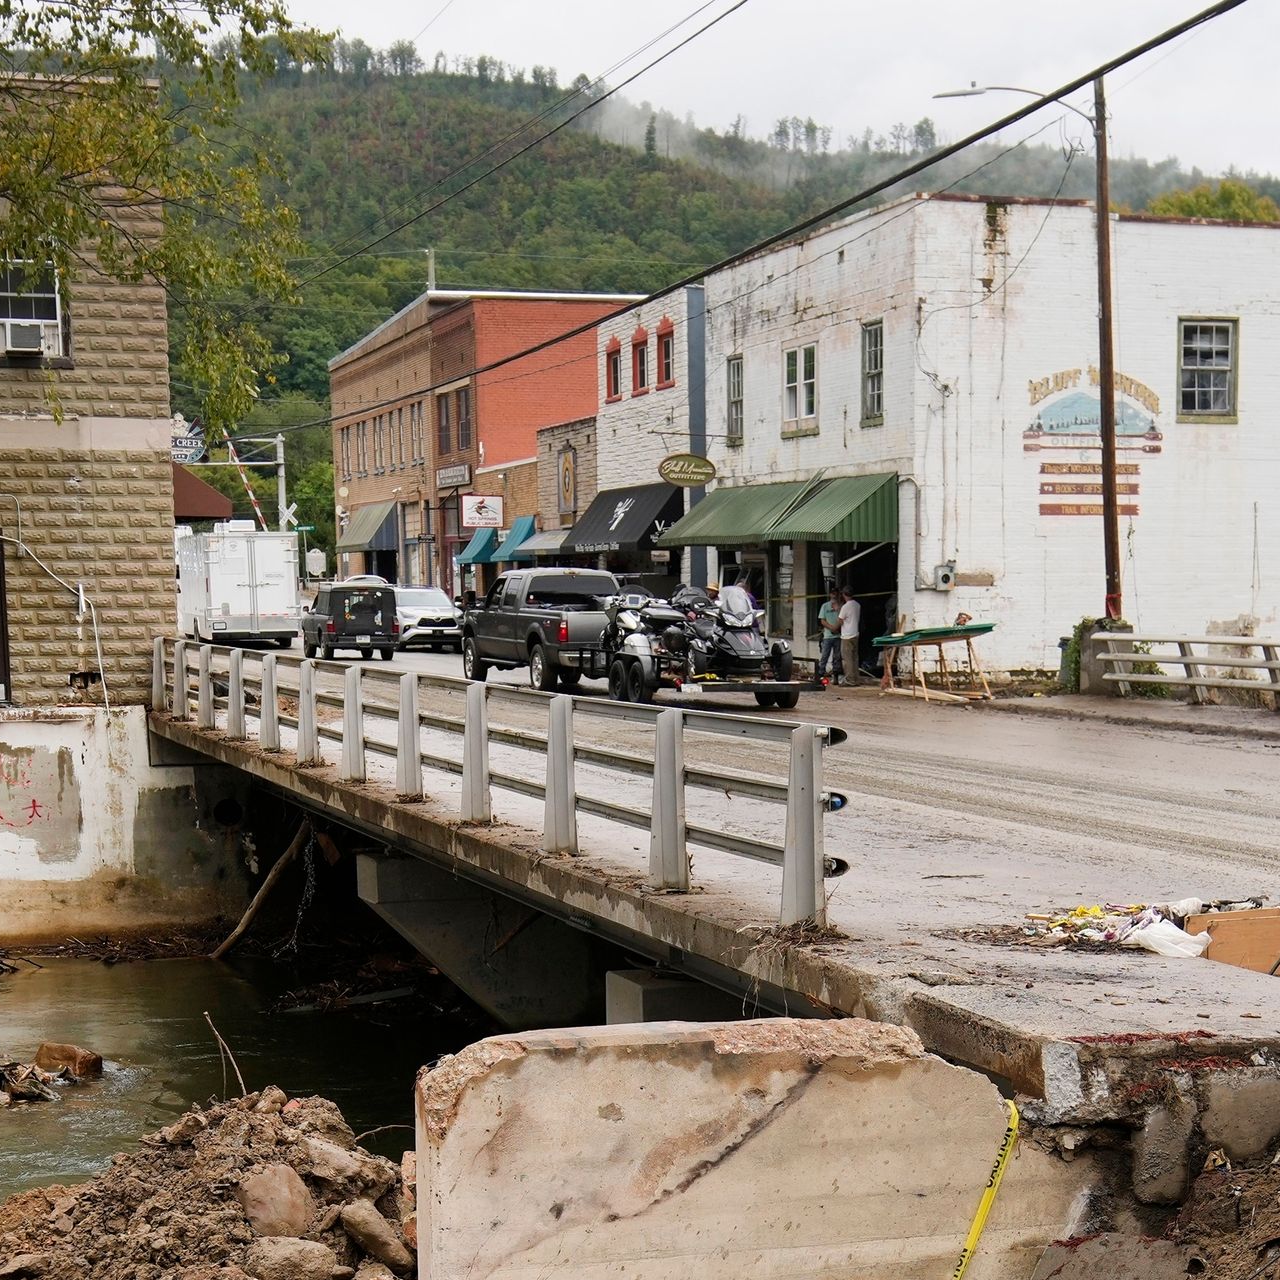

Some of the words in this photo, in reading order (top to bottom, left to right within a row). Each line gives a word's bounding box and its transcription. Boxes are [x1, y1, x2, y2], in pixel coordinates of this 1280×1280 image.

[1028, 369, 1081, 405] BLUFF
[1055, 484, 1077, 493] BOOKS
[1061, 505, 1078, 514] TRAIL
